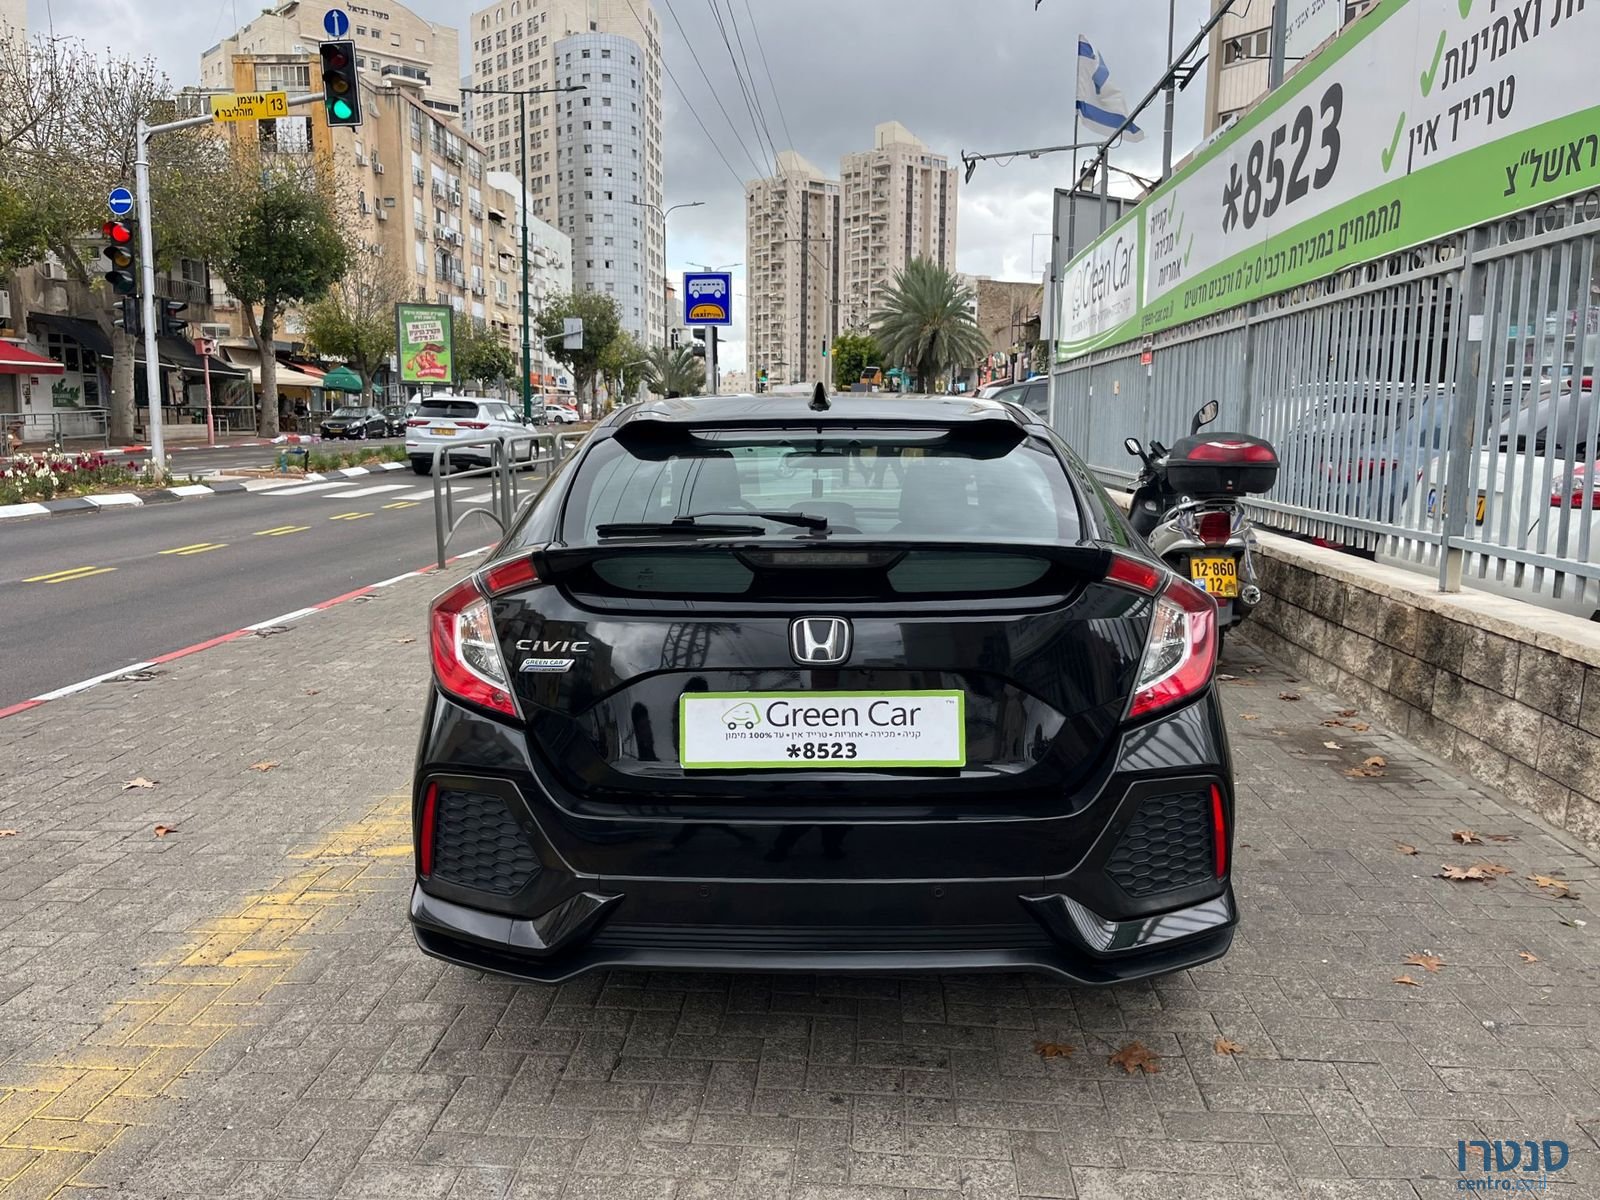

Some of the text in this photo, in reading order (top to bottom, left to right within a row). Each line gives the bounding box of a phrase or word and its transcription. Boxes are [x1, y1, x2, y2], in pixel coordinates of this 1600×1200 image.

[1442, 0, 1542, 91] ואמינות
[221, 106, 254, 117] מוהליבר
[237, 96, 258, 107] ויצמן
[270, 98, 283, 111] 13
[1406, 74, 1516, 176] טרייד אין
[1338, 199, 1401, 252] מתמחים
[1154, 232, 1174, 261] מכירה
[1288, 228, 1334, 272] במכירת
[1112, 236, 1134, 292] Car
[1158, 257, 1182, 288] אחריות
[1264, 250, 1287, 280] רכבי
[1208, 271, 1234, 300] ורכבים
[1184, 283, 1207, 310] חדשים
[1209, 577, 1224, 592] 12
[516, 640, 590, 652] CIVIC
[766, 700, 922, 728] Green Car
[725, 731, 746, 741] מימון
[791, 732, 804, 740] אין
[806, 731, 828, 739] טרייד
[834, 731, 863, 739] אחריות
[870, 731, 896, 739] מכירה
[901, 731, 921, 739] קניה
